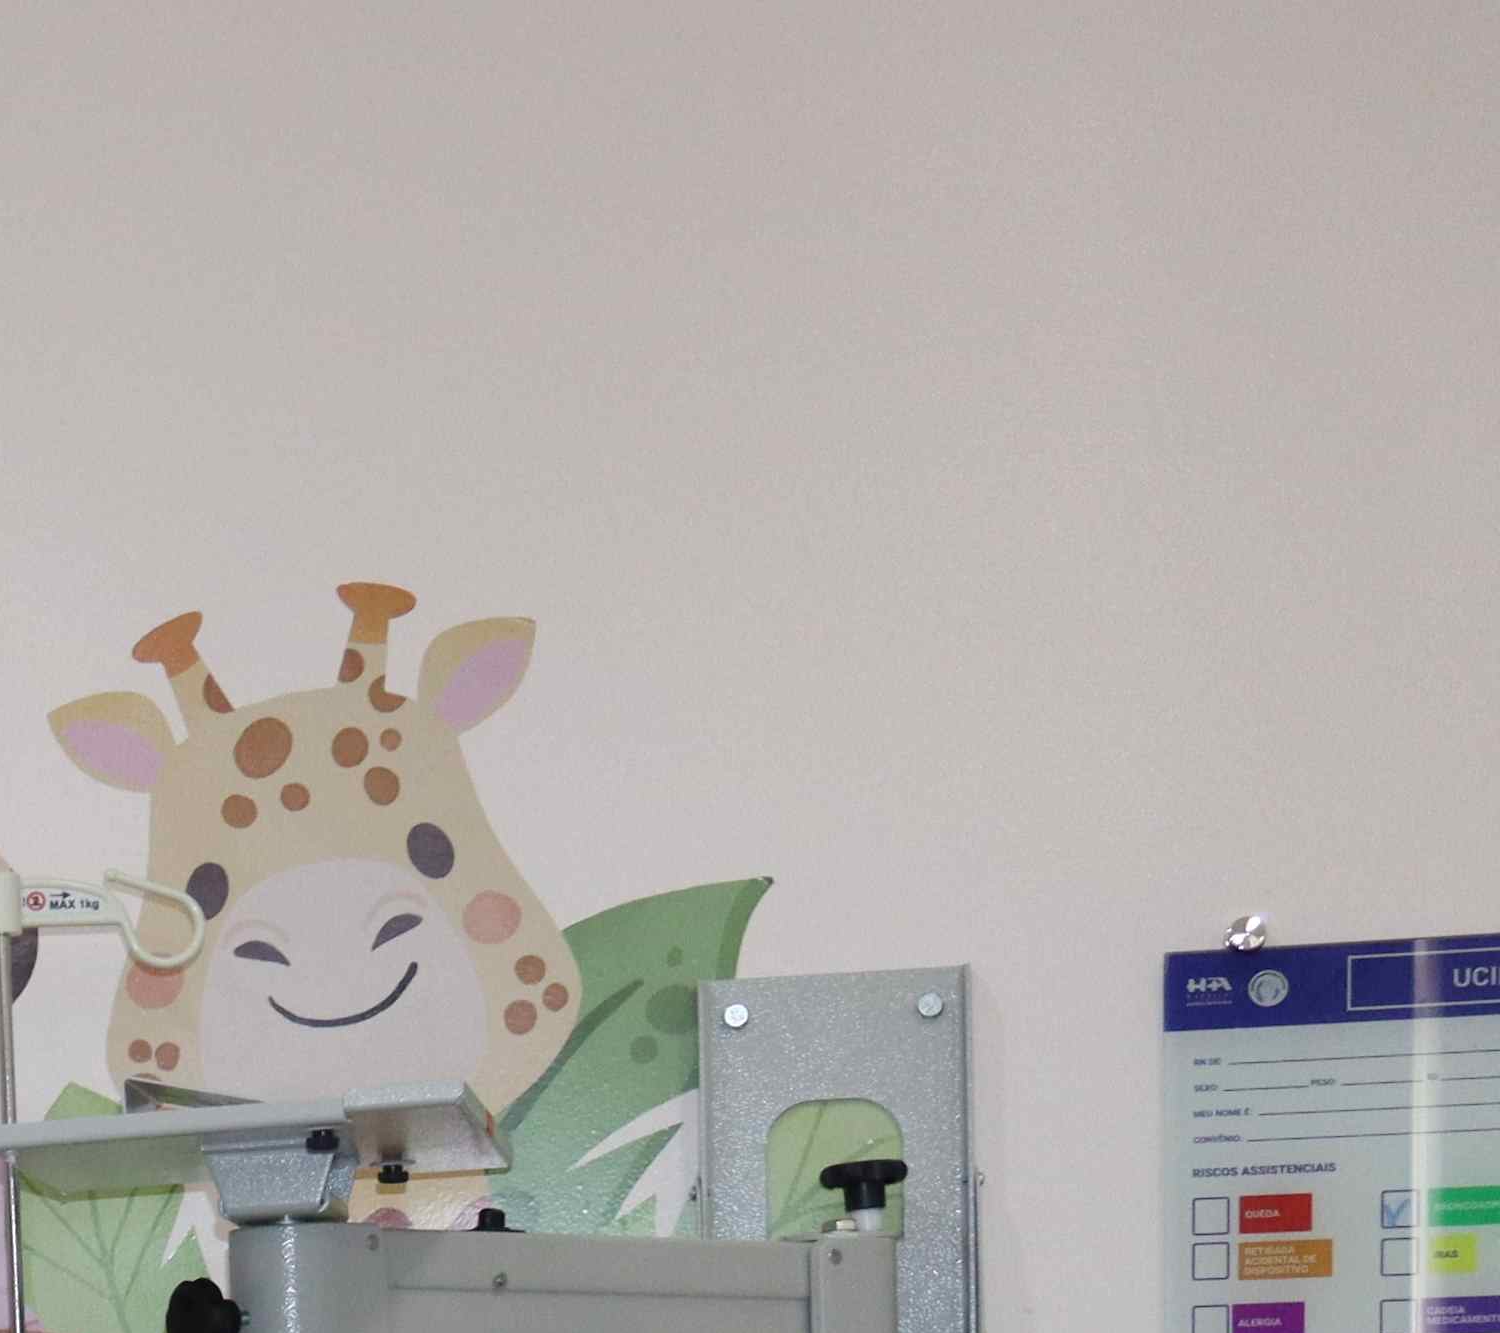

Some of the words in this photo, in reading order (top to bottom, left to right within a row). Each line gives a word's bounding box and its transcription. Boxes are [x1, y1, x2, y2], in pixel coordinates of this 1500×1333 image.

[50, 900, 75, 910] MAX
[1453, 966, 1500, 987] UCI
[1192, 1166, 1238, 1178] RISCOS
[1241, 1162, 1336, 1176] ASSISTENCIAIS
